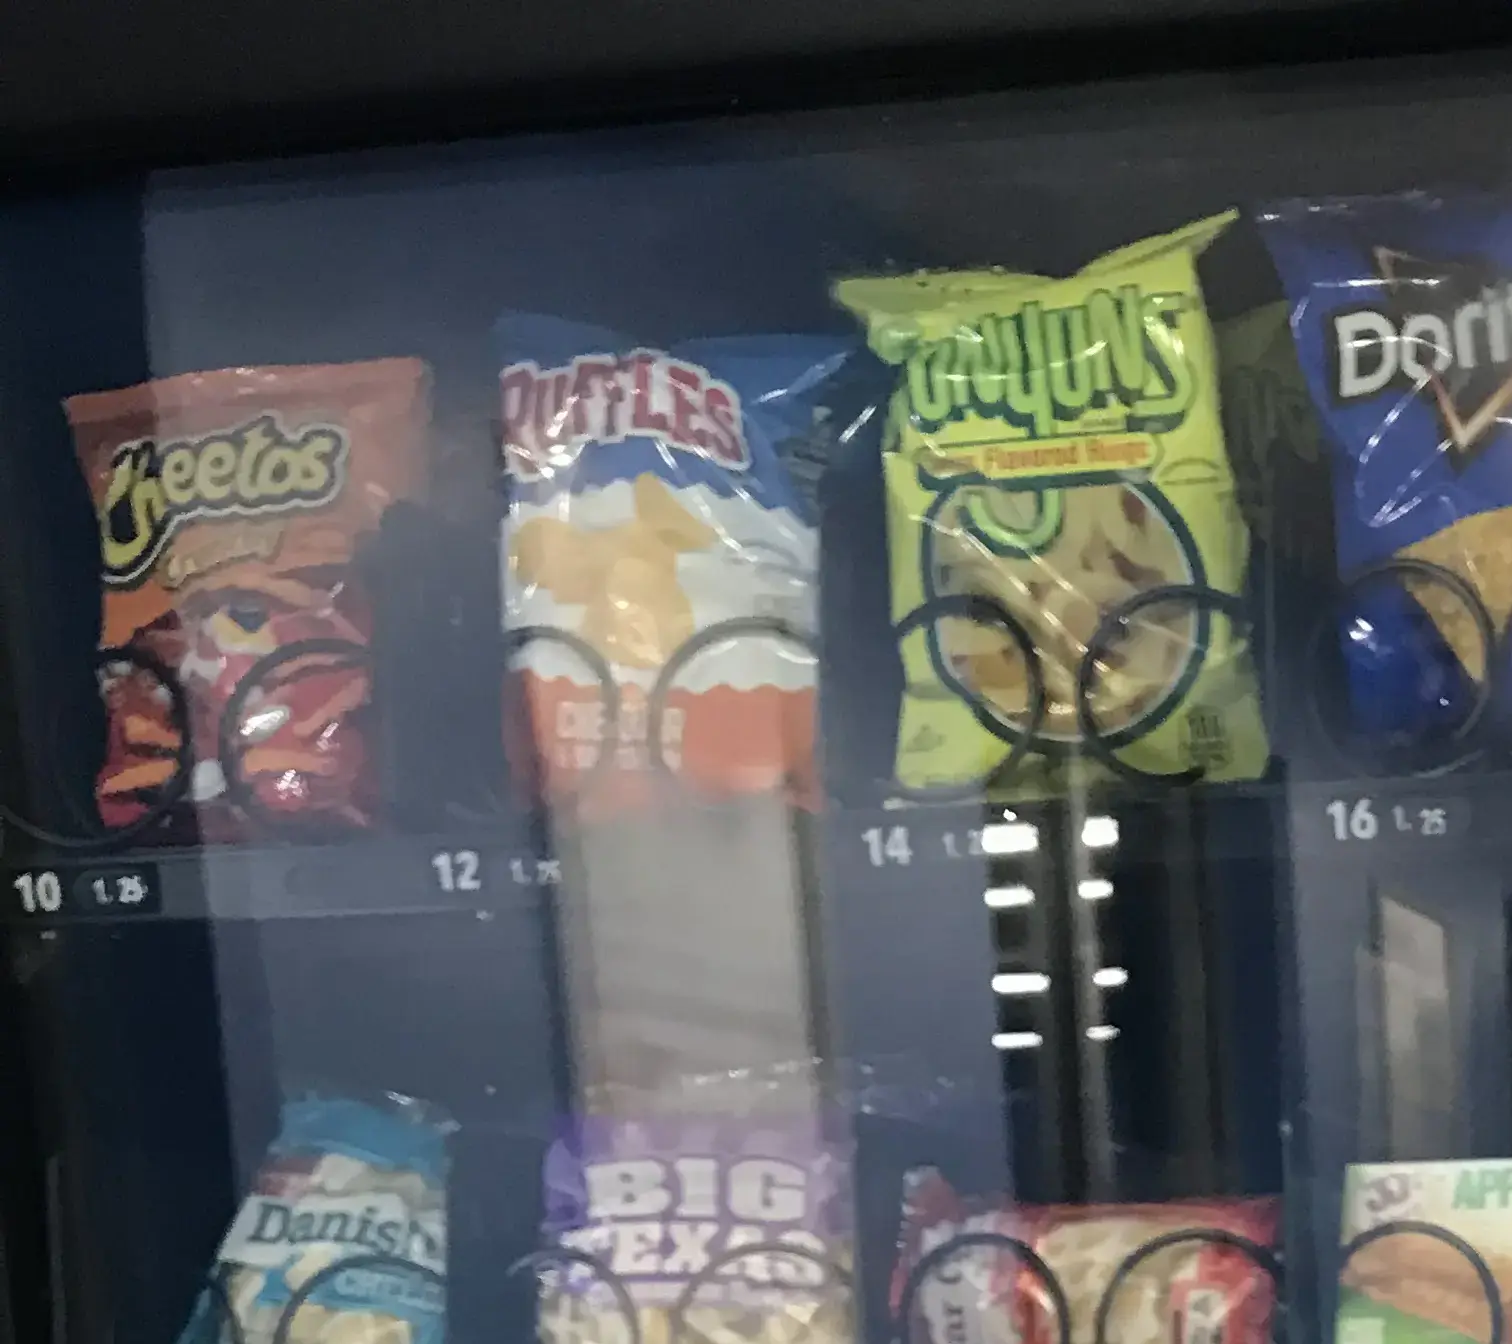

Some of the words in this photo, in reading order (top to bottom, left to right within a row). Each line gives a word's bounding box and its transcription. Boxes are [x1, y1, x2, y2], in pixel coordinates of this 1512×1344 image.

[105, 423, 340, 568] Cheetos
[1326, 799, 1378, 840] 16
[861, 826, 914, 868] 14
[12, 870, 62, 913] 10
[431, 849, 482, 892] 12
[585, 1157, 807, 1222] BIG
